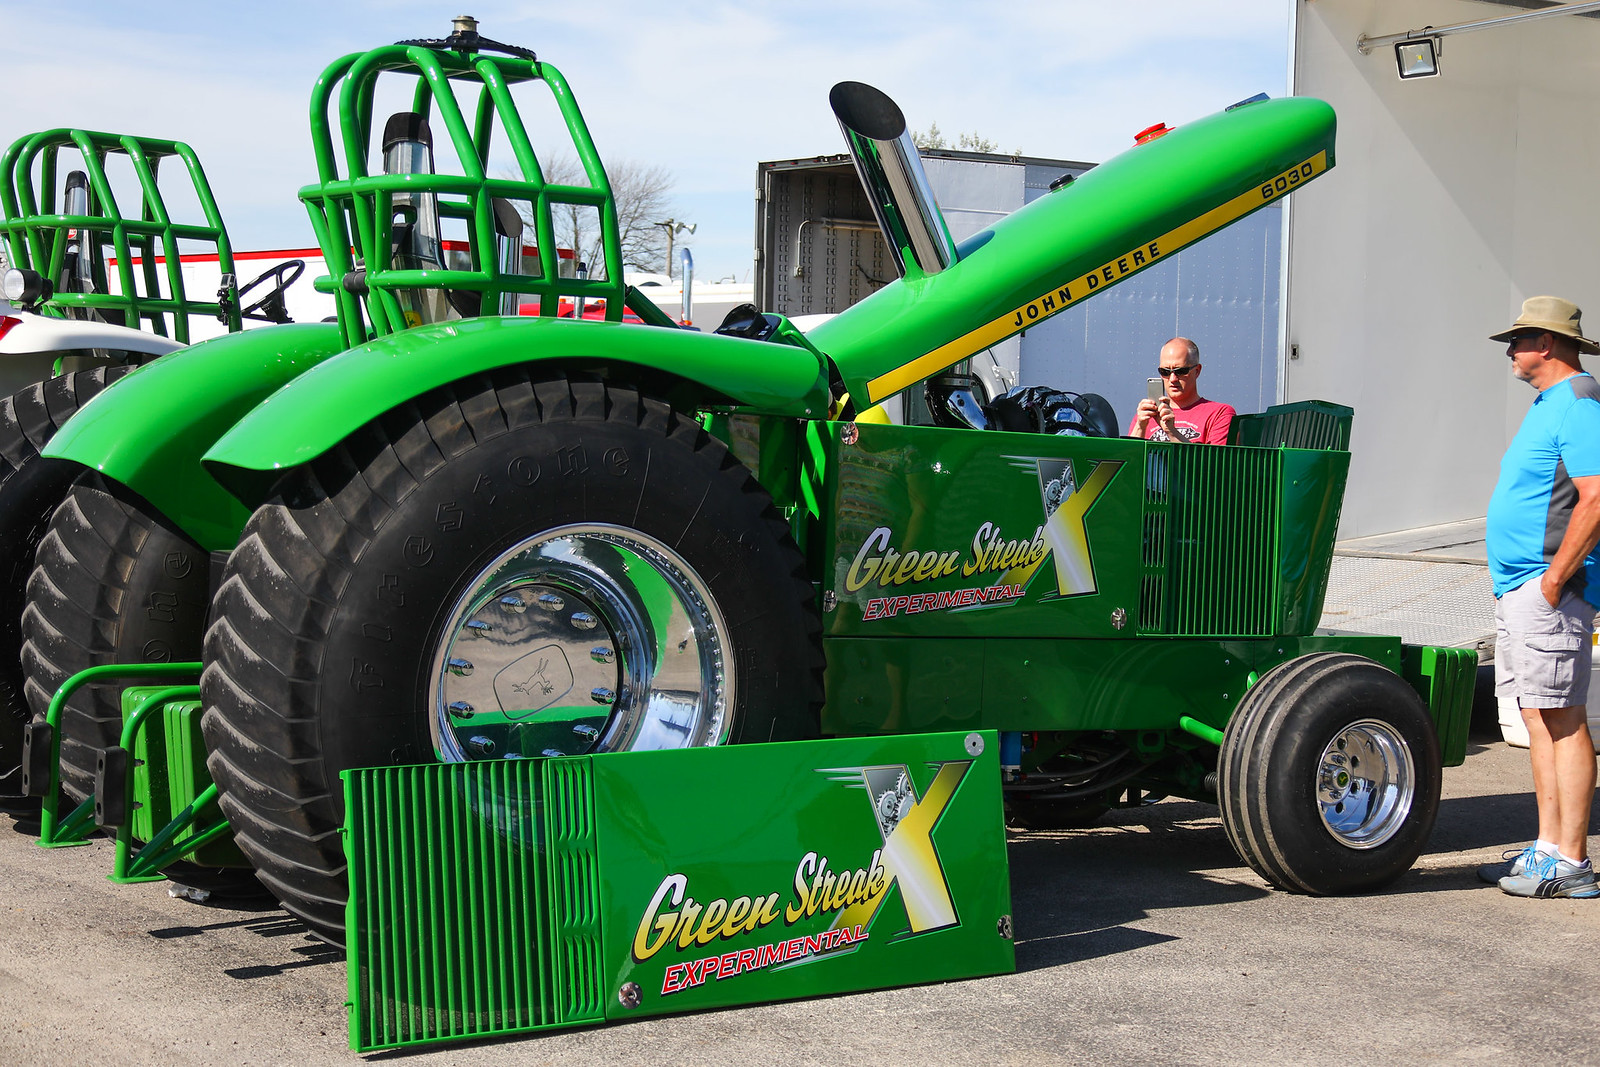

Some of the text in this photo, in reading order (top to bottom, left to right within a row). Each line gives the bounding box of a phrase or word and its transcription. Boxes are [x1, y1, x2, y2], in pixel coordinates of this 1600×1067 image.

[1261, 161, 1314, 200] 6030
[1014, 242, 1161, 327] JOHN DEERE
[844, 525, 960, 595] Green
[961, 520, 1046, 580] Streak
[862, 583, 1027, 623] EXPERIMENTAL
[632, 873, 781, 964] Green
[784, 850, 886, 927] Streak
[660, 923, 870, 996] EXPERIMENTAL
